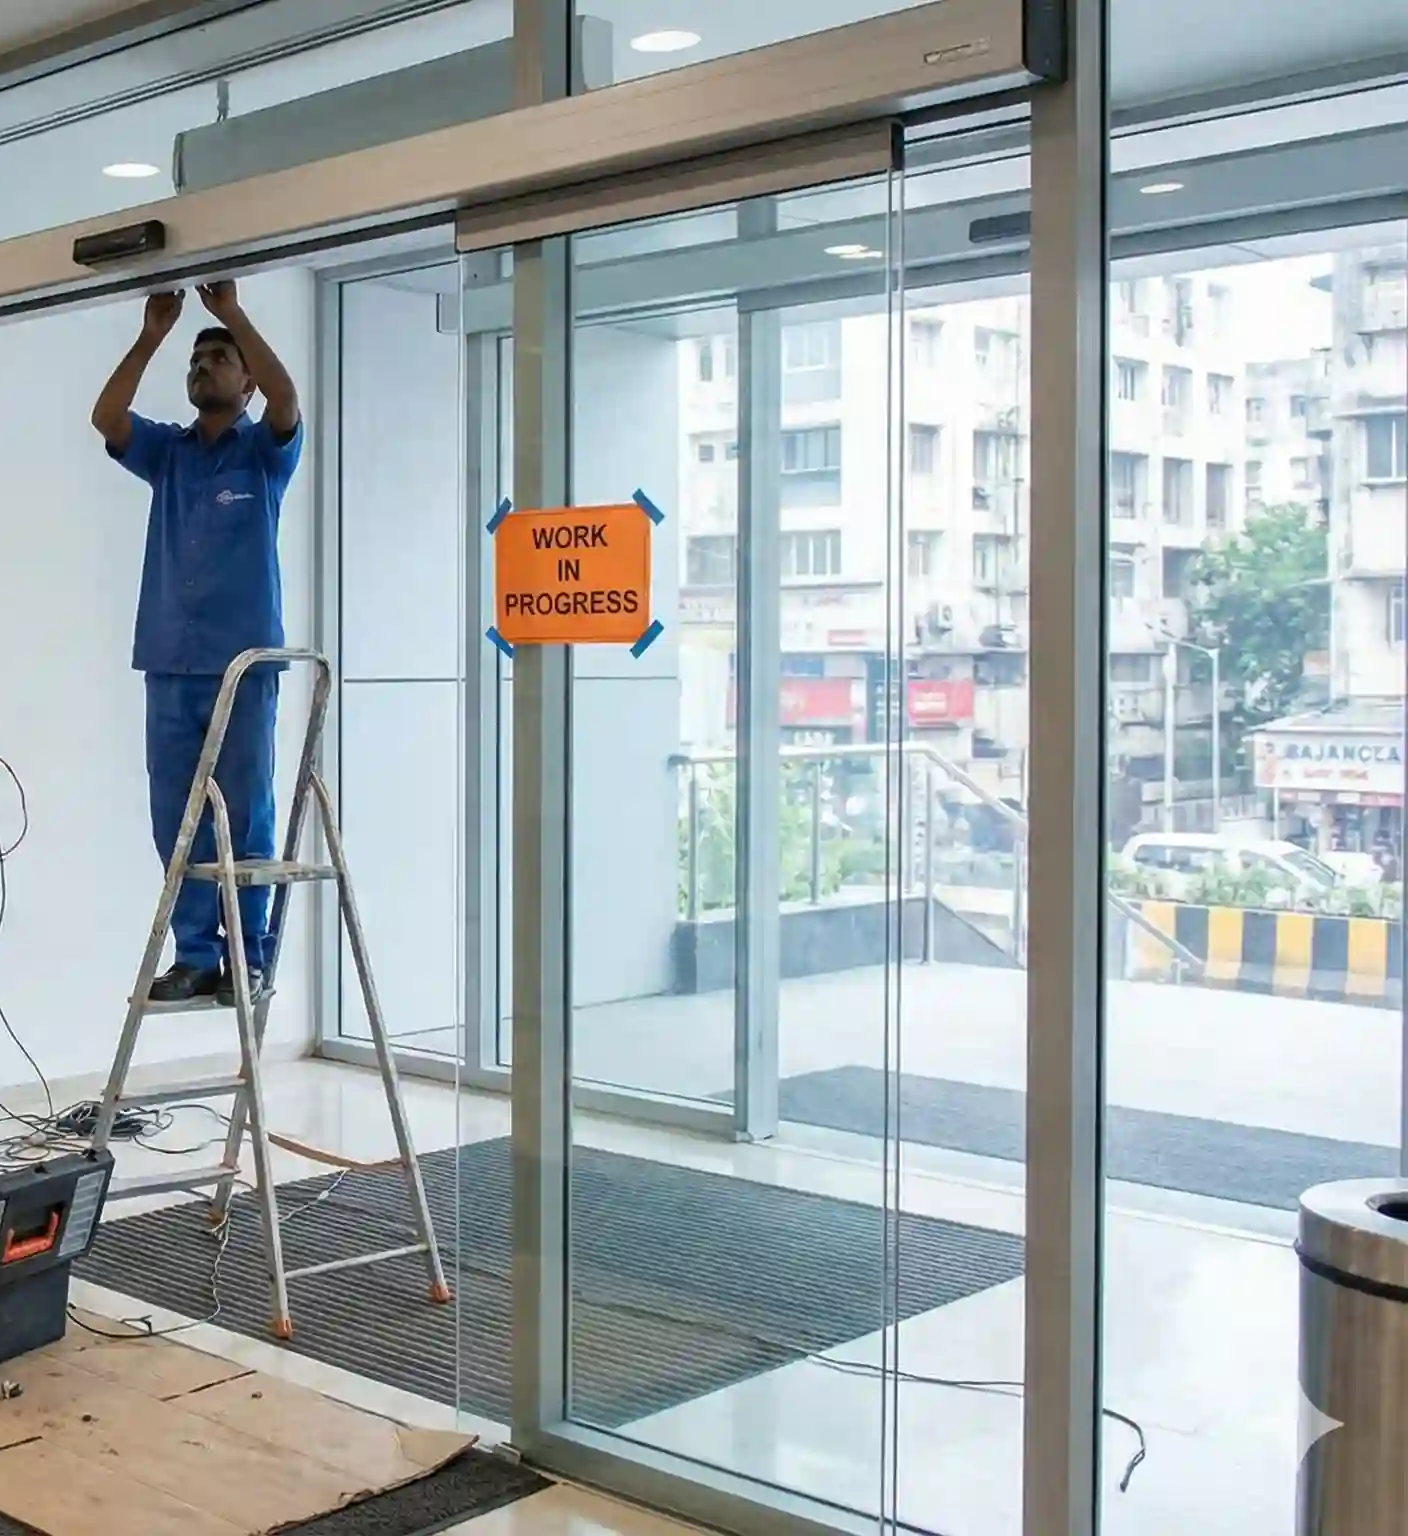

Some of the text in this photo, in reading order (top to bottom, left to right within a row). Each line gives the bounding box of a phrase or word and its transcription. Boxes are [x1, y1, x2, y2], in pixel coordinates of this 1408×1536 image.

[532, 524, 608, 549] WORK
[558, 559, 580, 581] IN
[505, 590, 638, 616] PROGRESS
